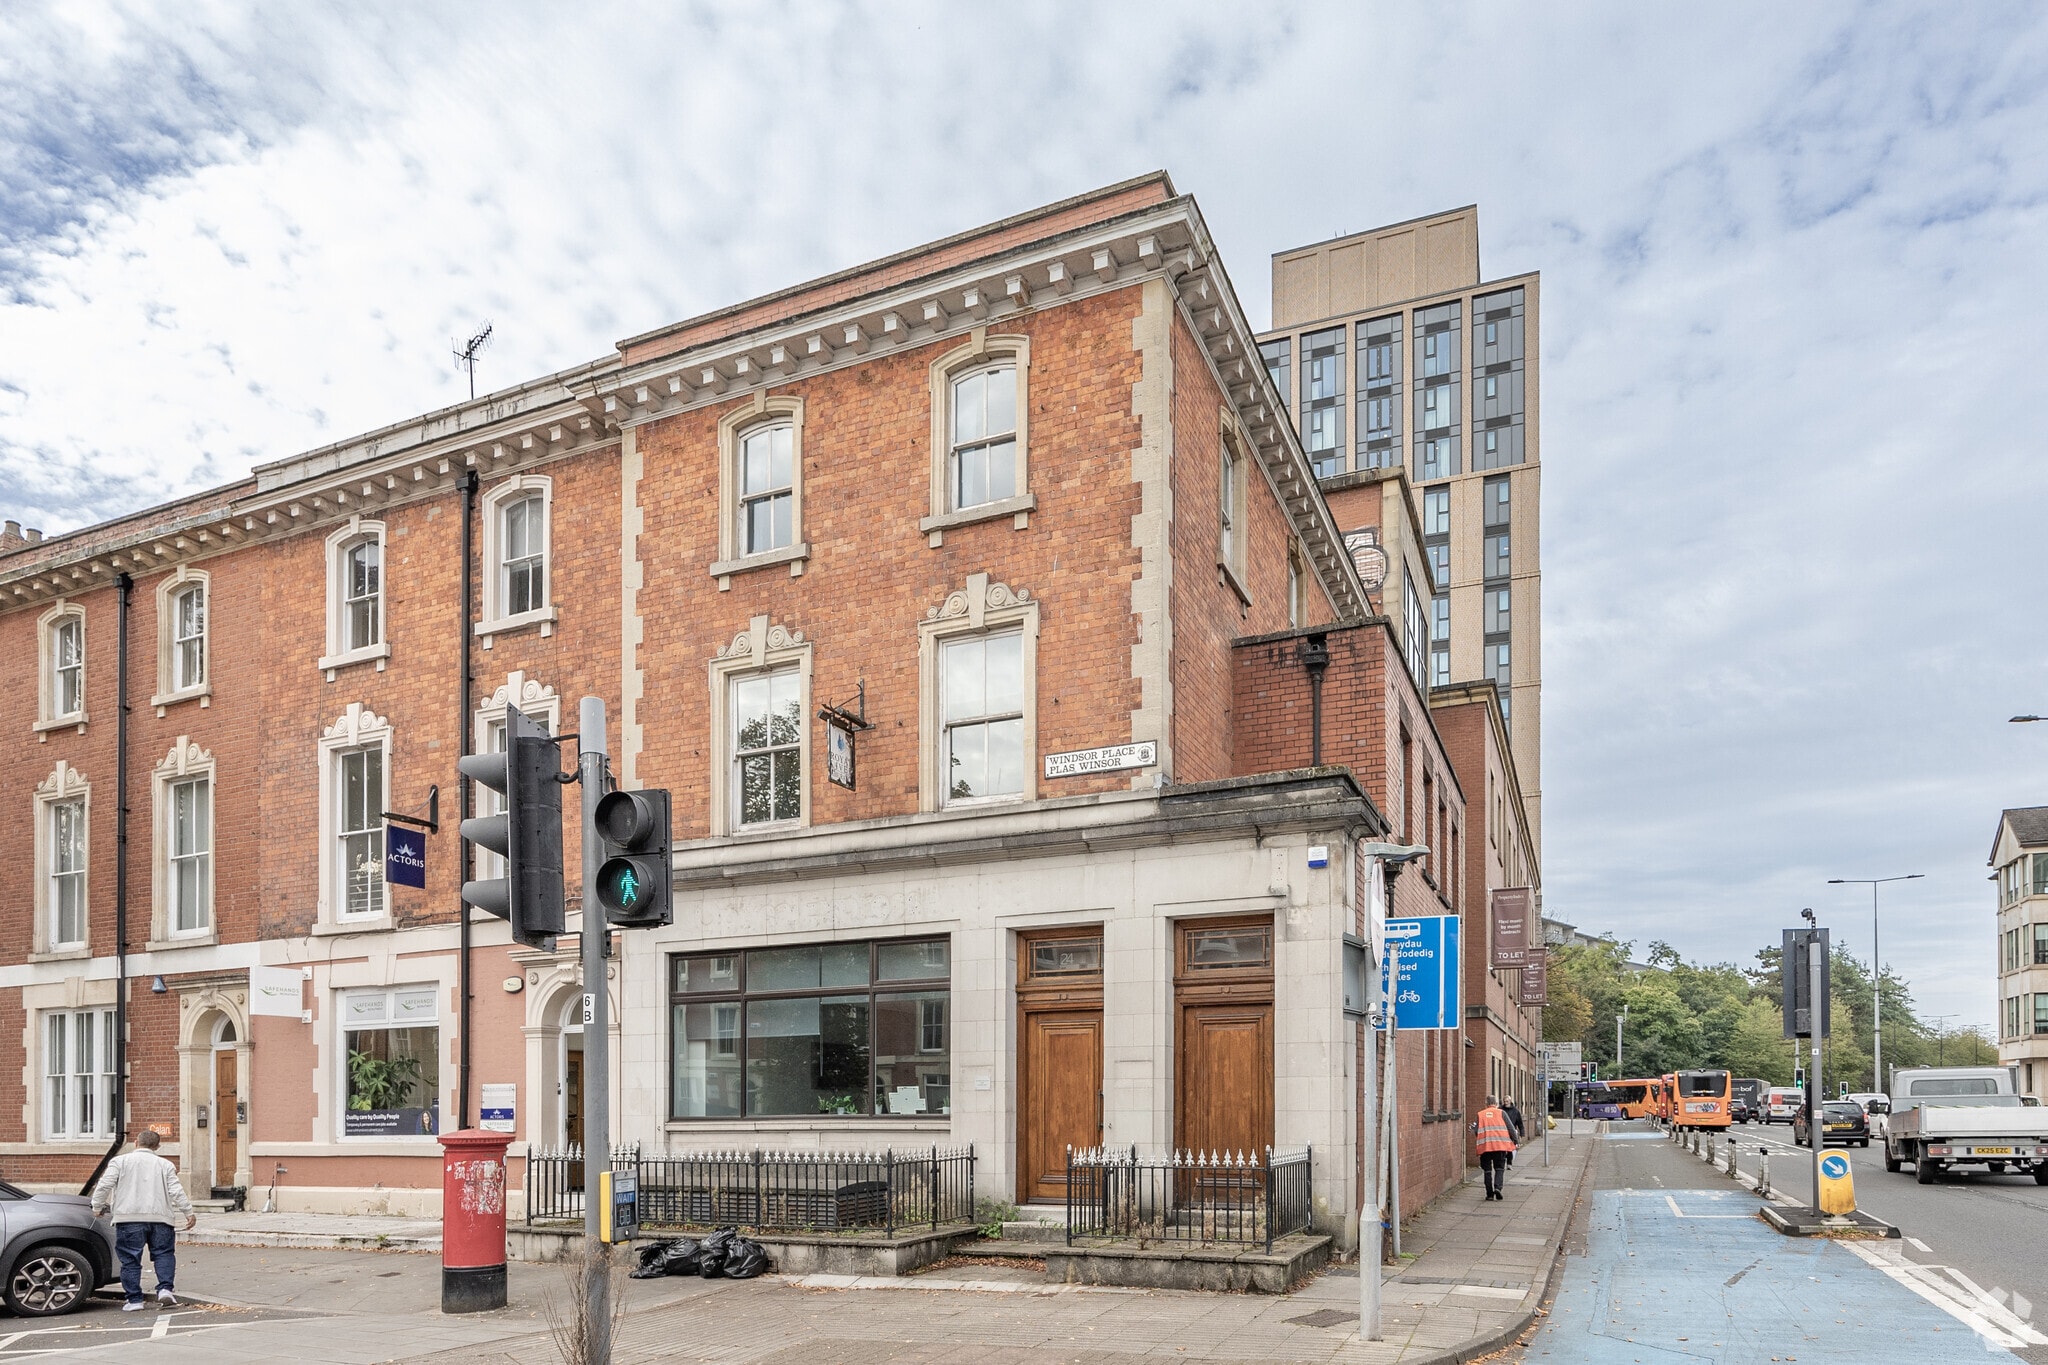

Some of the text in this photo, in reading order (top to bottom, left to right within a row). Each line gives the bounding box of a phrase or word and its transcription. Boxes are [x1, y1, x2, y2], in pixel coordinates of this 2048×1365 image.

[1049, 751, 1098, 765] WINDSOR
[1101, 746, 1136, 759] PLACE
[1049, 757, 1122, 775] PLAS WINSOR
[388, 853, 424, 868] ACTORIS
[1384, 940, 1422, 950] eydau
[1060, 952, 1074, 965] 24
[1383, 949, 1434, 959] dudodedig
[584, 996, 590, 1006] 6
[584, 1010, 592, 1022] B
[616, 1192, 636, 1204] WAIT
